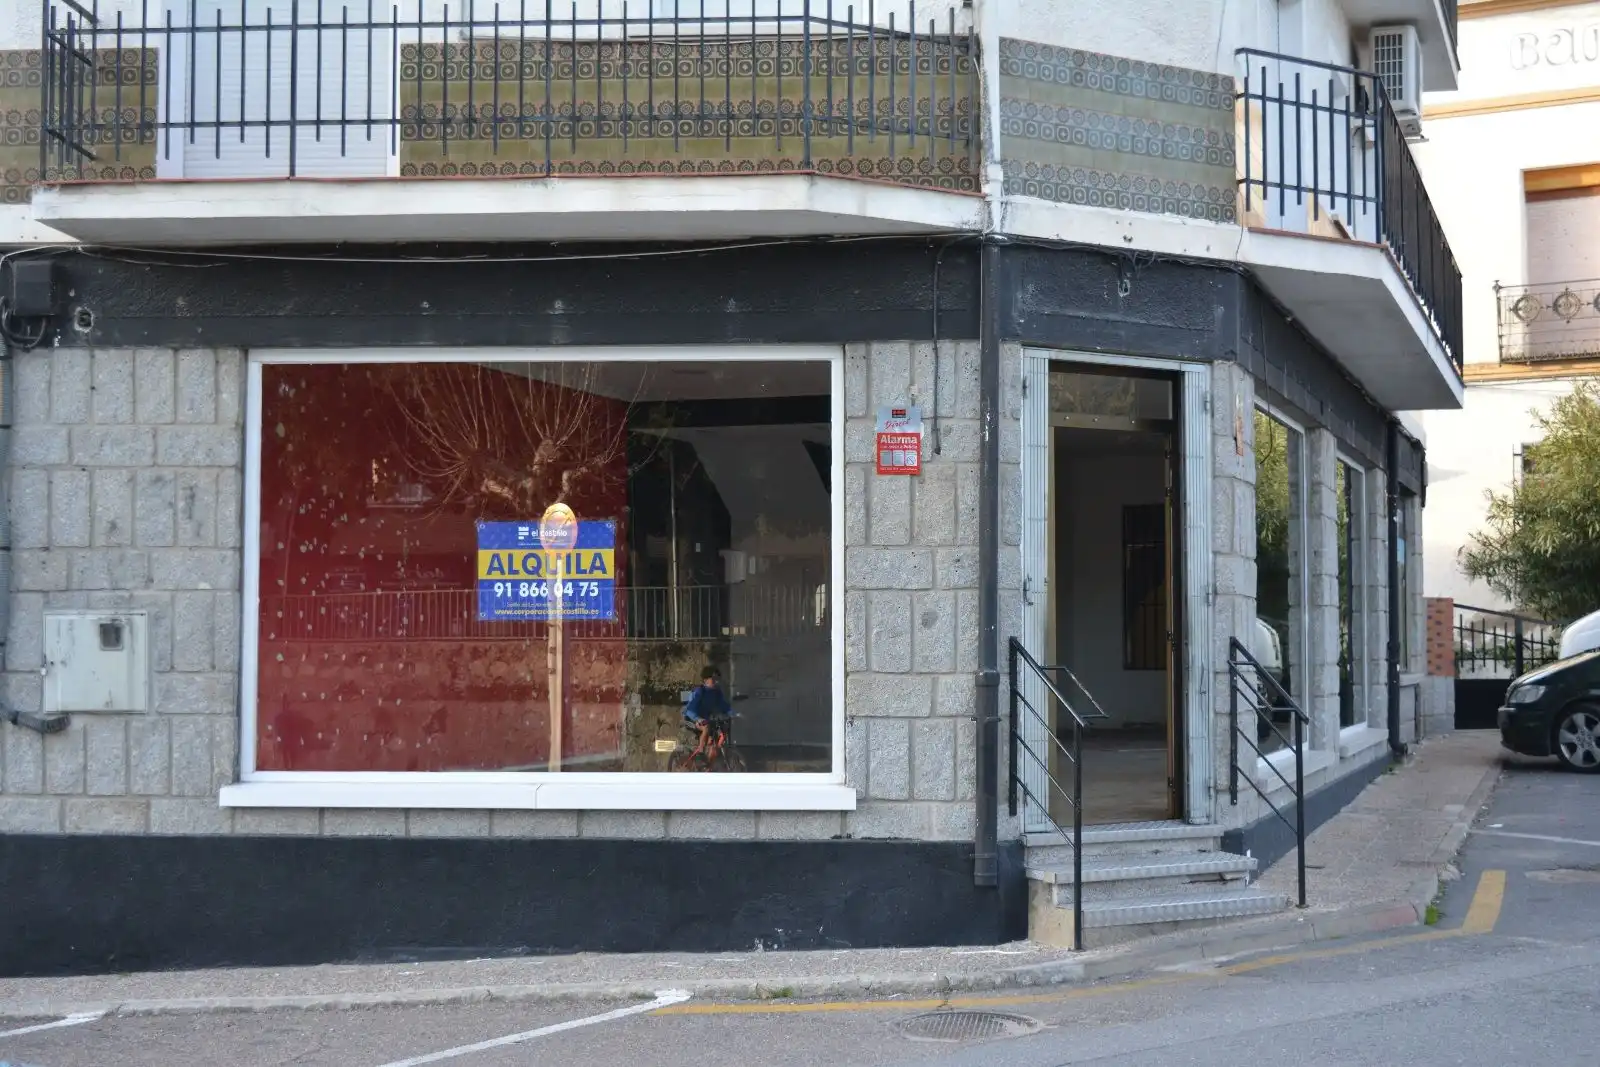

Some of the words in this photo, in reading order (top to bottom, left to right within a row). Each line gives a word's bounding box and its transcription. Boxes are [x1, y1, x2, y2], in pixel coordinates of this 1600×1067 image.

[880, 434, 918, 444] Alarma
[531, 529, 539, 537] el
[486, 552, 608, 577] ALQUILA
[494, 582, 512, 597] 91
[519, 582, 548, 597] 866
[553, 582, 574, 597] 04
[579, 582, 599, 597] 75
